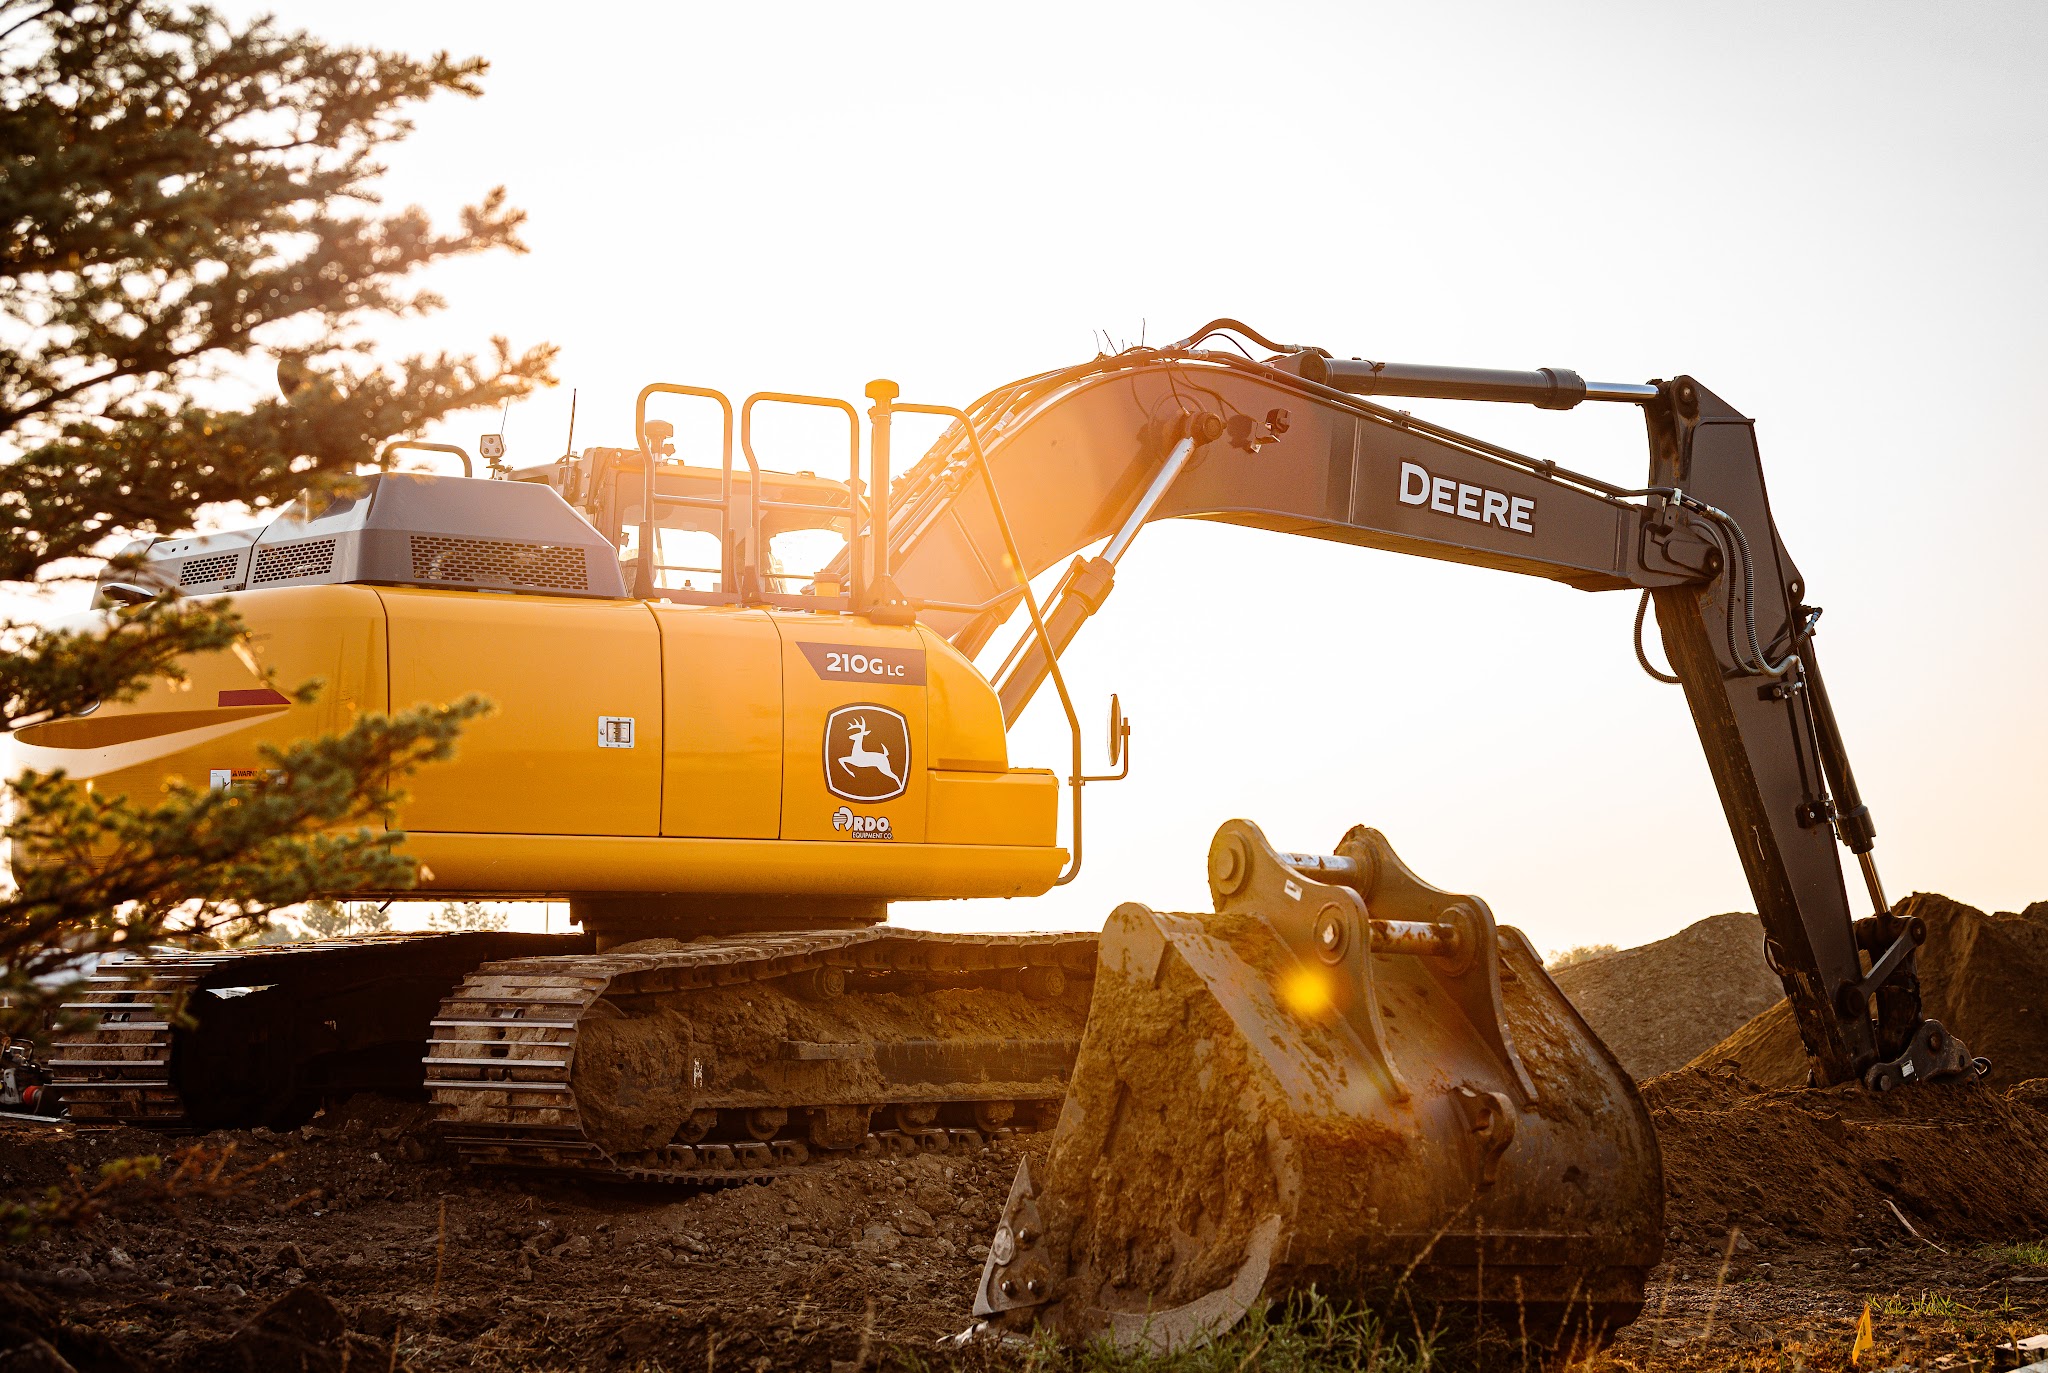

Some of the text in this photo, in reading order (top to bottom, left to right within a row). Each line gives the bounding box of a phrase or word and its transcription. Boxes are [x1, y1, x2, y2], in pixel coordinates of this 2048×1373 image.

[1400, 461, 1534, 534] DEERE
[826, 652, 905, 676] 210G LC
[853, 816, 890, 832] RDO
